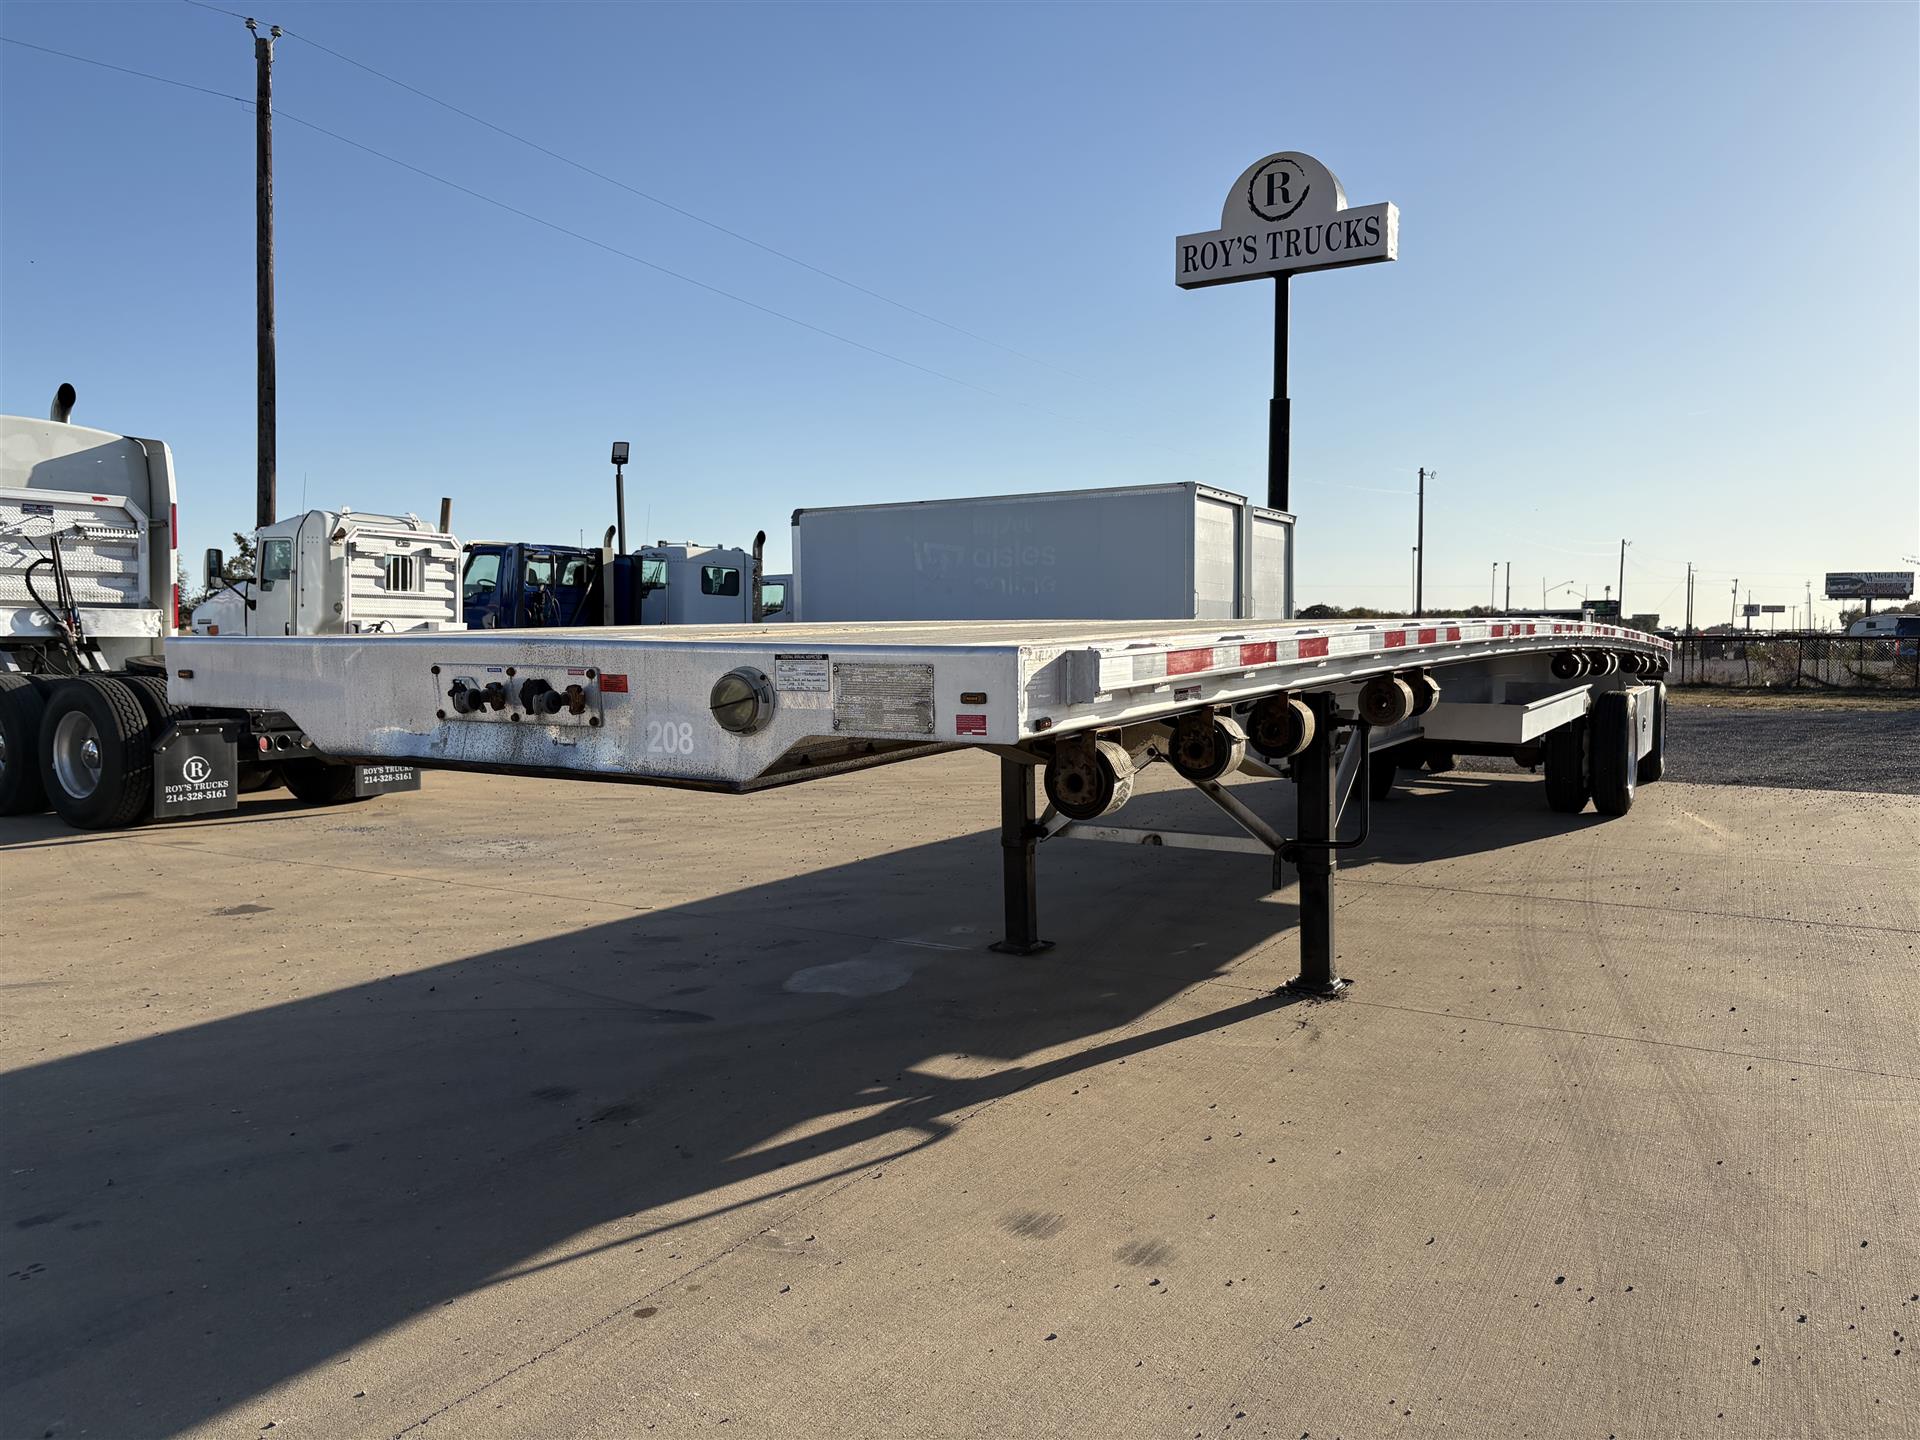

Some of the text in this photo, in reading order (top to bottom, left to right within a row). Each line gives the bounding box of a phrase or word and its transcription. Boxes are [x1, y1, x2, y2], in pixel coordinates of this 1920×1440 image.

[1263, 171, 1293, 207] R
[1182, 215, 1380, 274] ROY'S TRUCKS
[647, 720, 694, 755] 208
[190, 761, 204, 777] R
[363, 766, 384, 775] ROY'S
[364, 772, 412, 784] 214-328-5161
[165, 780, 229, 793] ROY'S TRUCKS
[166, 789, 227, 803] 214-328-5161
